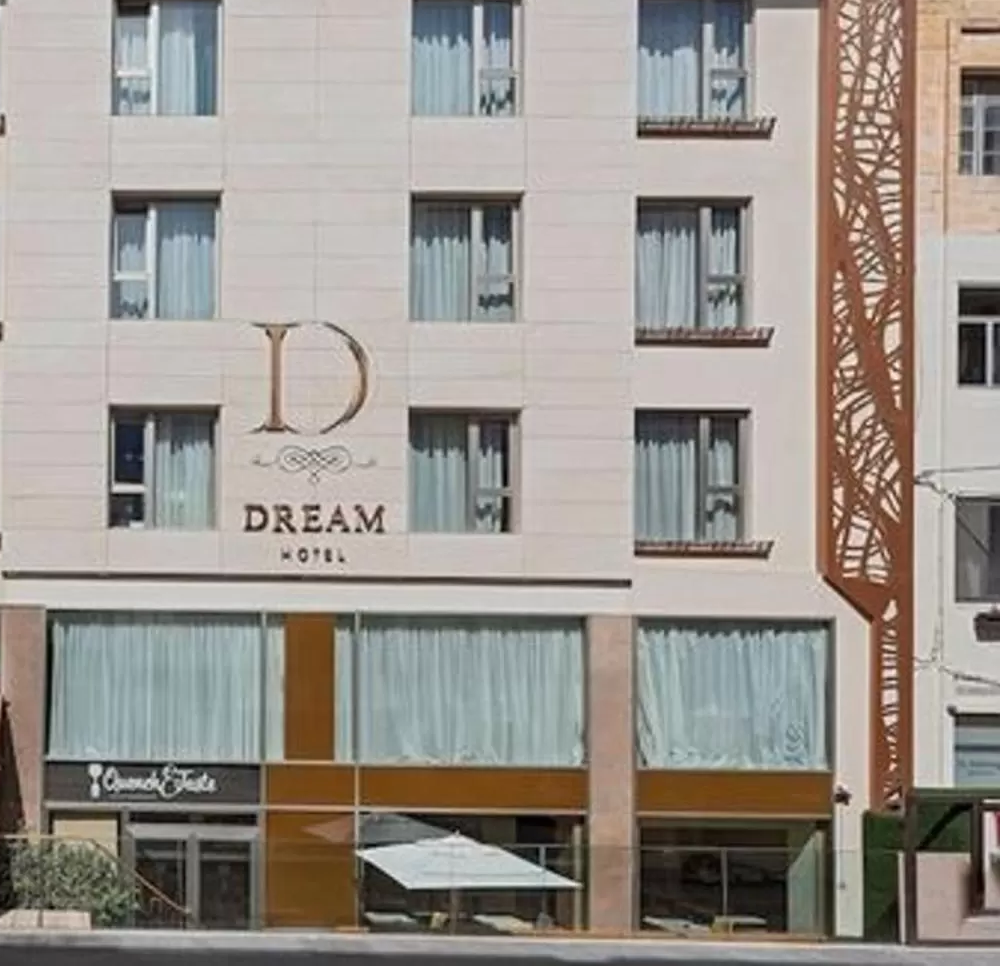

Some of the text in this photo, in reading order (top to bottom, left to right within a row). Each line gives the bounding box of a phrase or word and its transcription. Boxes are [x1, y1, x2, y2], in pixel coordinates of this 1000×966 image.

[249, 320, 370, 435] D
[244, 504, 386, 534] DREAM
[280, 547, 346, 563] HOTEL
